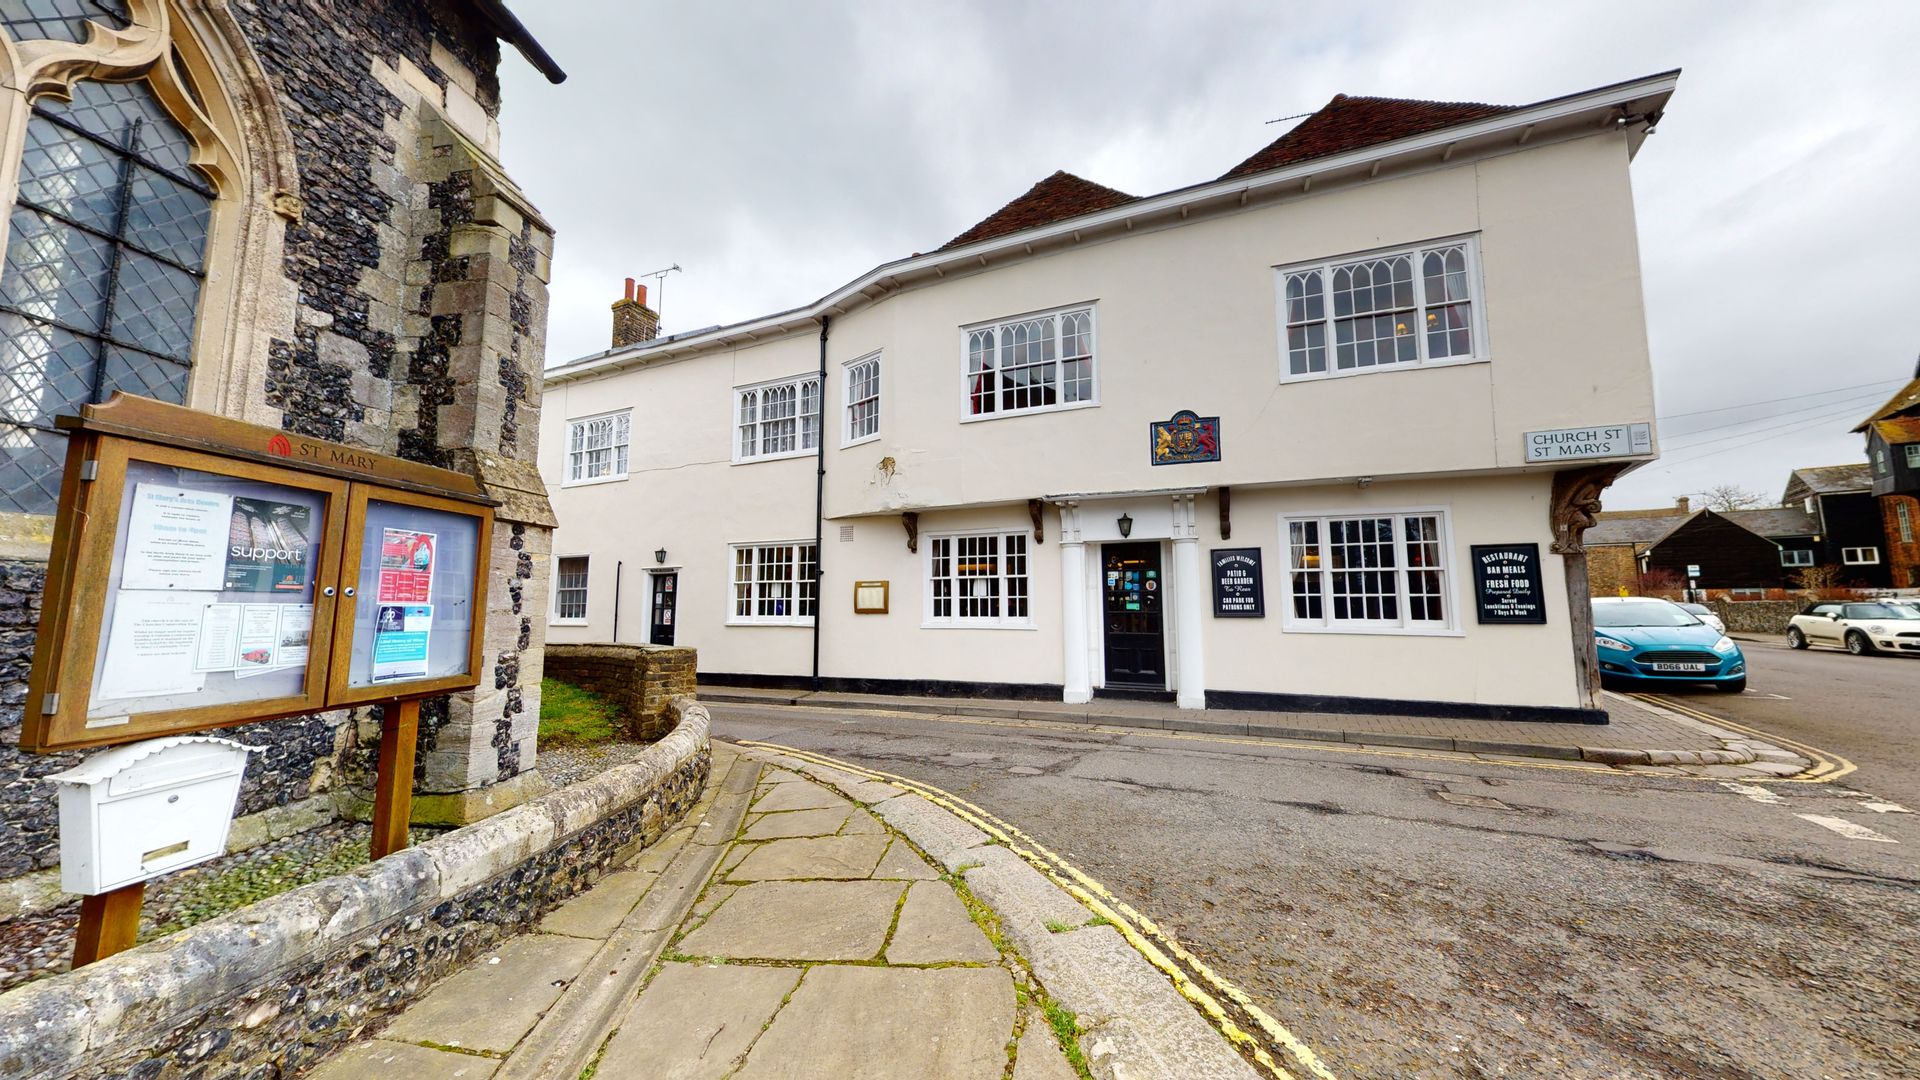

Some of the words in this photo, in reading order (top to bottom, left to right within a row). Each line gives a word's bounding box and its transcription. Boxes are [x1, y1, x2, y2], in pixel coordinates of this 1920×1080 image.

[1533, 431, 1597, 445] CHURCH
[1605, 429, 1622, 440] ST
[1534, 447, 1551, 457] ST
[1559, 442, 1611, 456] MARYS
[300, 443, 321, 458] ST
[330, 450, 377, 470] MARY
[231, 545, 302, 562] support
[1481, 552, 1528, 564] RESTAURANT
[1216, 556, 1236, 567] FAMILIES
[1236, 556, 1256, 566] WELCOME
[1486, 566, 1500, 574] BAR
[1502, 566, 1526, 574] MEALS
[1486, 580, 1509, 588] FRESH
[1511, 579, 1530, 588] FOOD
